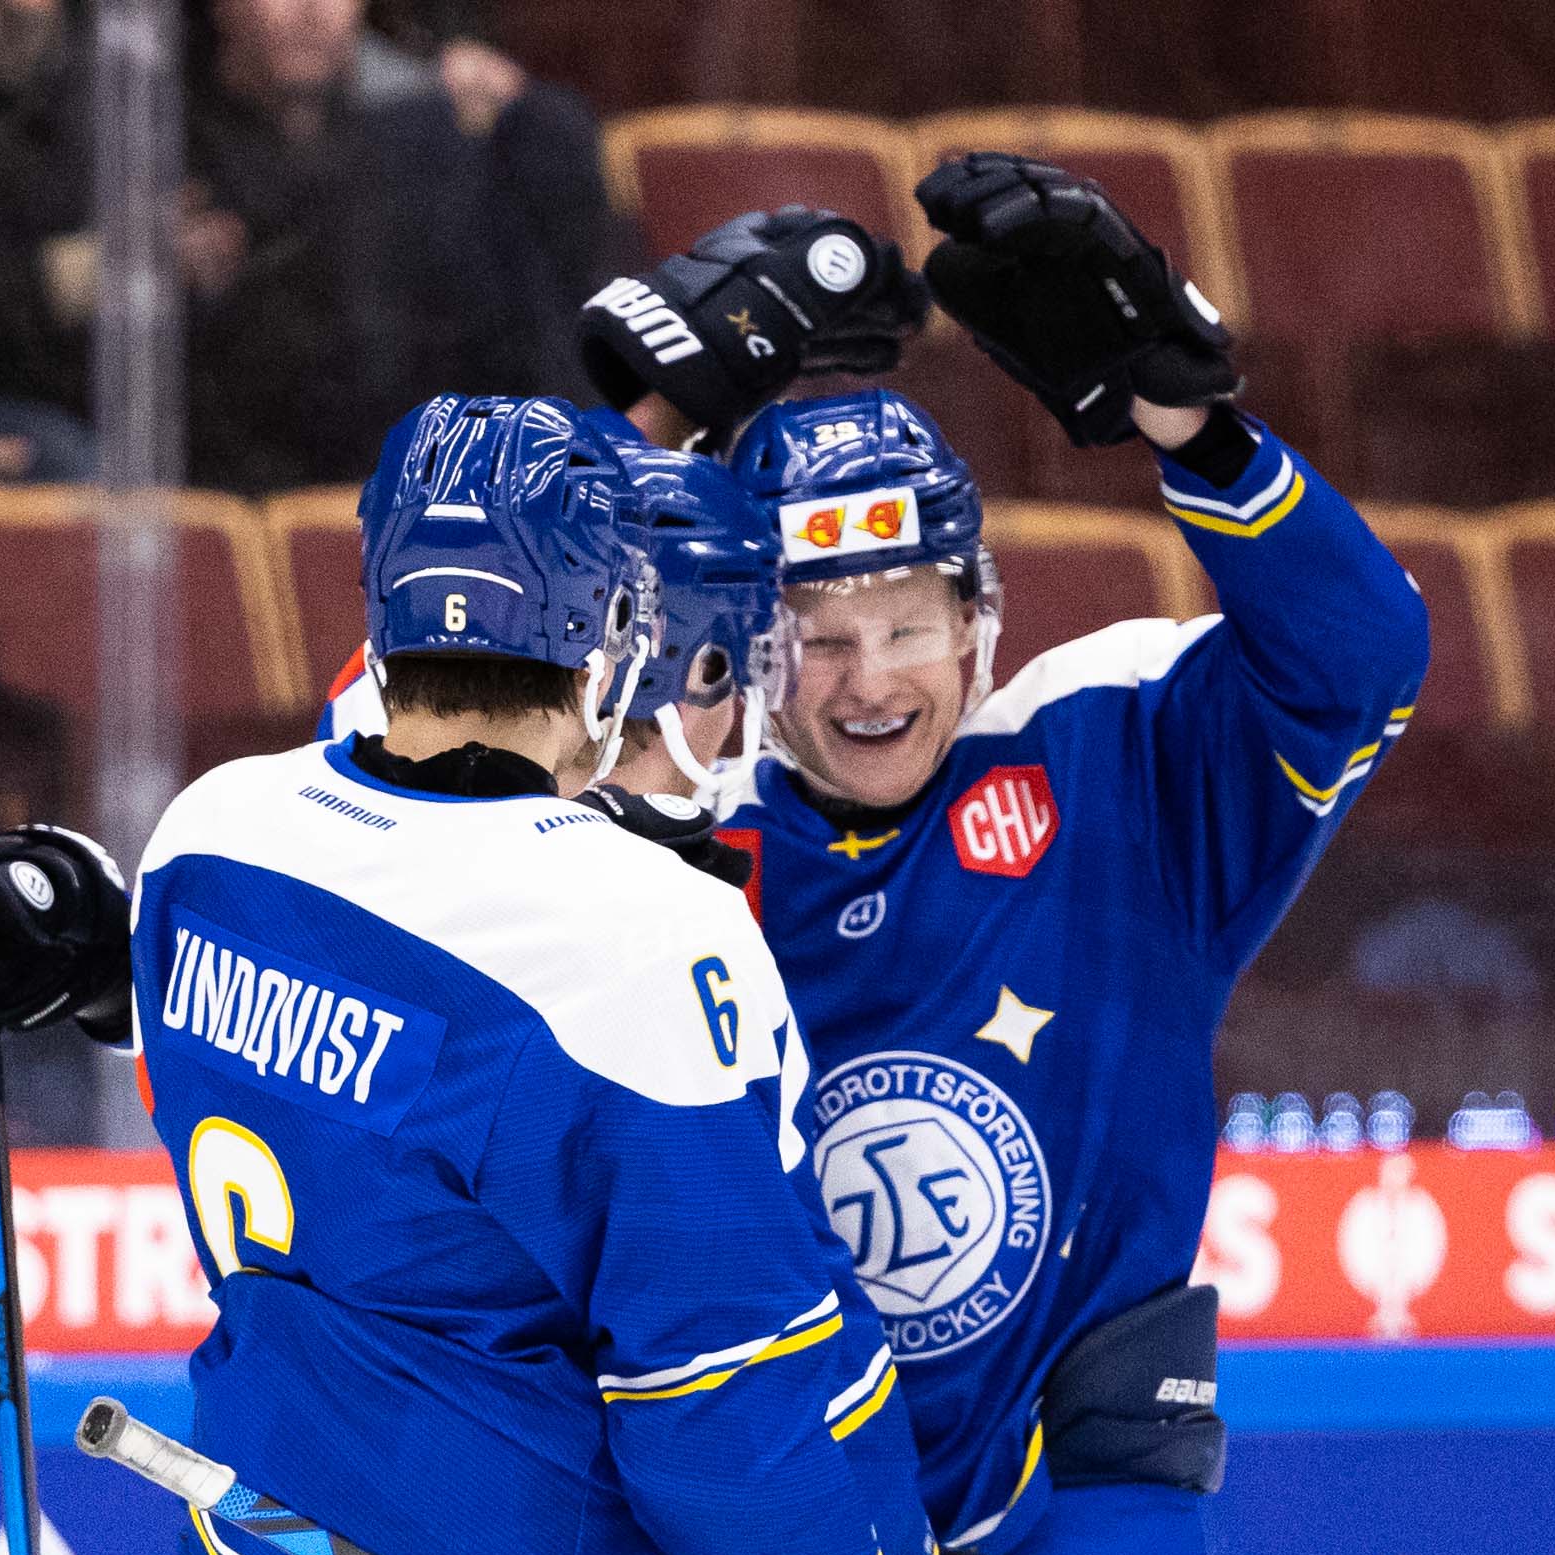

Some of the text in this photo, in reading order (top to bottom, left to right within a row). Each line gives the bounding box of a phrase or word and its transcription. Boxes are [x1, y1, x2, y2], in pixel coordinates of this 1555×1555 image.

[443, 593, 468, 632] 6
[297, 785, 398, 833] WARRIOR
[958, 781, 1052, 865] CHL
[162, 926, 406, 1105] UNDQVIST
[689, 954, 740, 1071] 6
